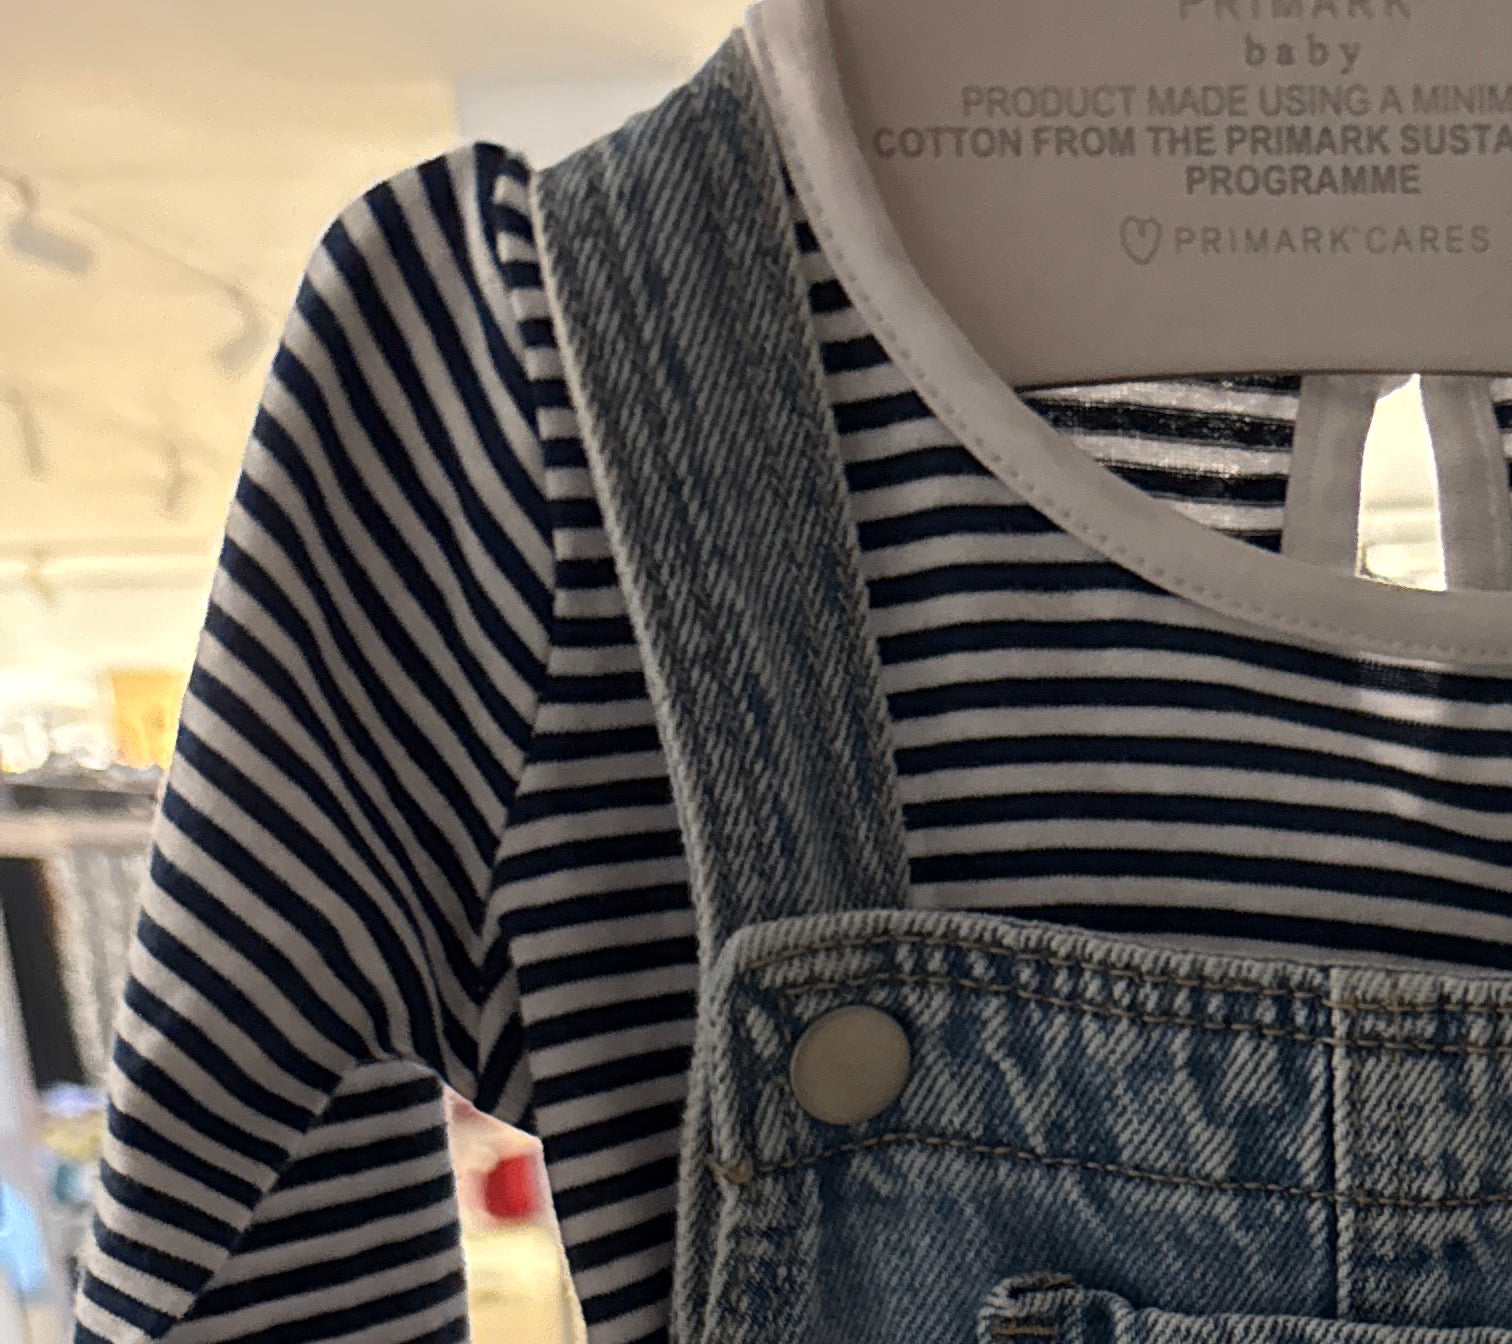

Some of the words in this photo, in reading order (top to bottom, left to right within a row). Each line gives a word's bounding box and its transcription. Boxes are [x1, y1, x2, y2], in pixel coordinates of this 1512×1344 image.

[1245, 33, 1361, 75] baby
[961, 84, 1138, 118] PRODUCT
[1147, 84, 1249, 117] MADE
[1257, 83, 1370, 117] USING
[1378, 84, 1404, 115] A
[872, 124, 1024, 159] COTTON
[1031, 124, 1137, 158] FROM
[1146, 124, 1218, 157] THE
[1224, 123, 1392, 157] PRIMARK
[1184, 163, 1422, 197] PROGRAMME
[1366, 223, 1491, 254] CARES
